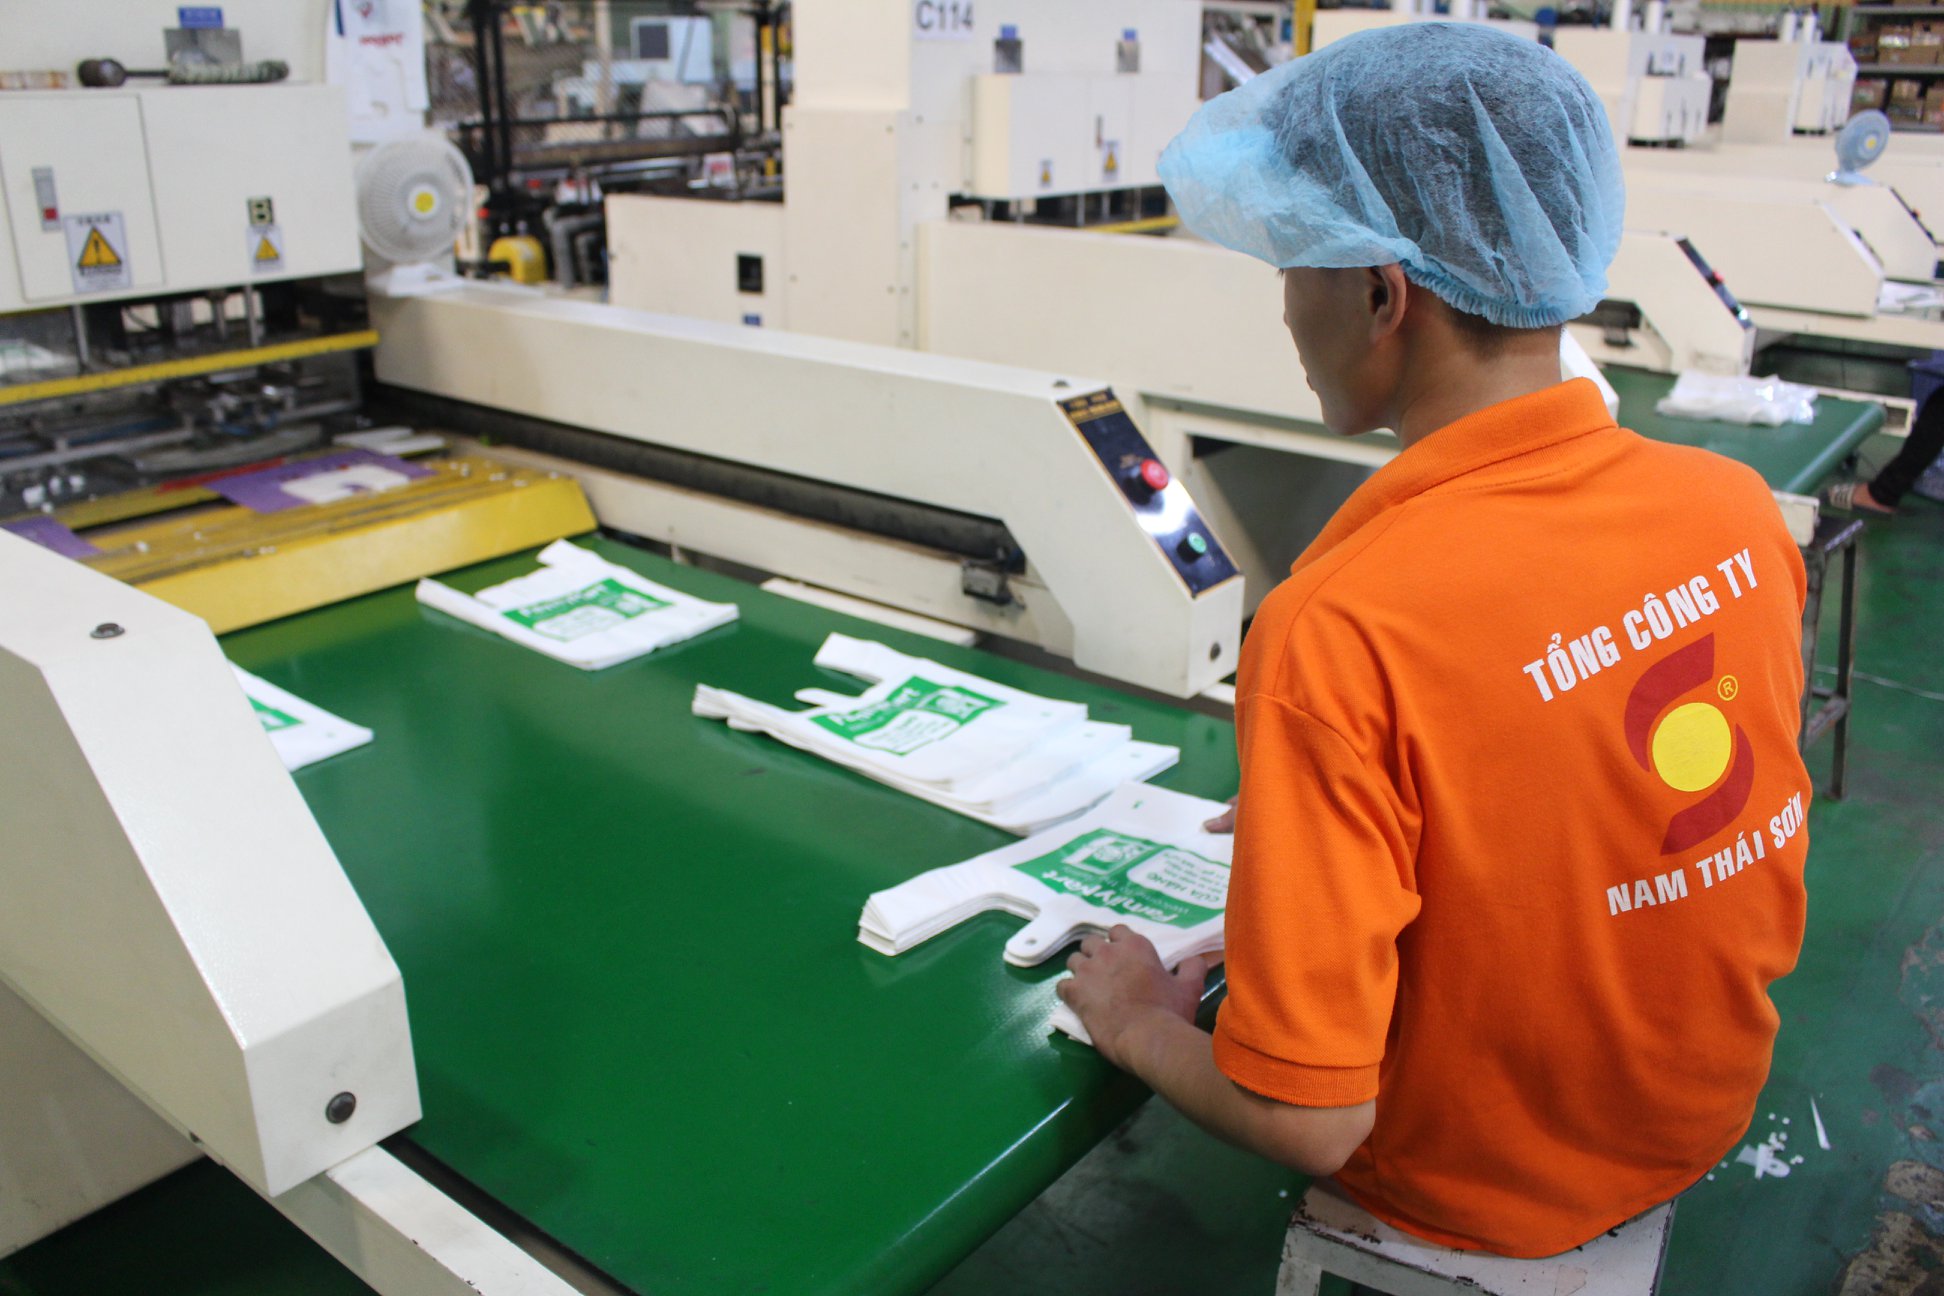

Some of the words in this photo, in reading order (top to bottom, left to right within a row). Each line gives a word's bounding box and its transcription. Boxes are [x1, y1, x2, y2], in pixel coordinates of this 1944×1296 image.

[915, 0, 974, 31] C114
[1523, 625, 1621, 702] TỔNG
[1622, 575, 1720, 651] CÔNG
[1716, 548, 1758, 599] TY
[1606, 868, 1688, 916] NAM
[1696, 831, 1766, 889] THÁI
